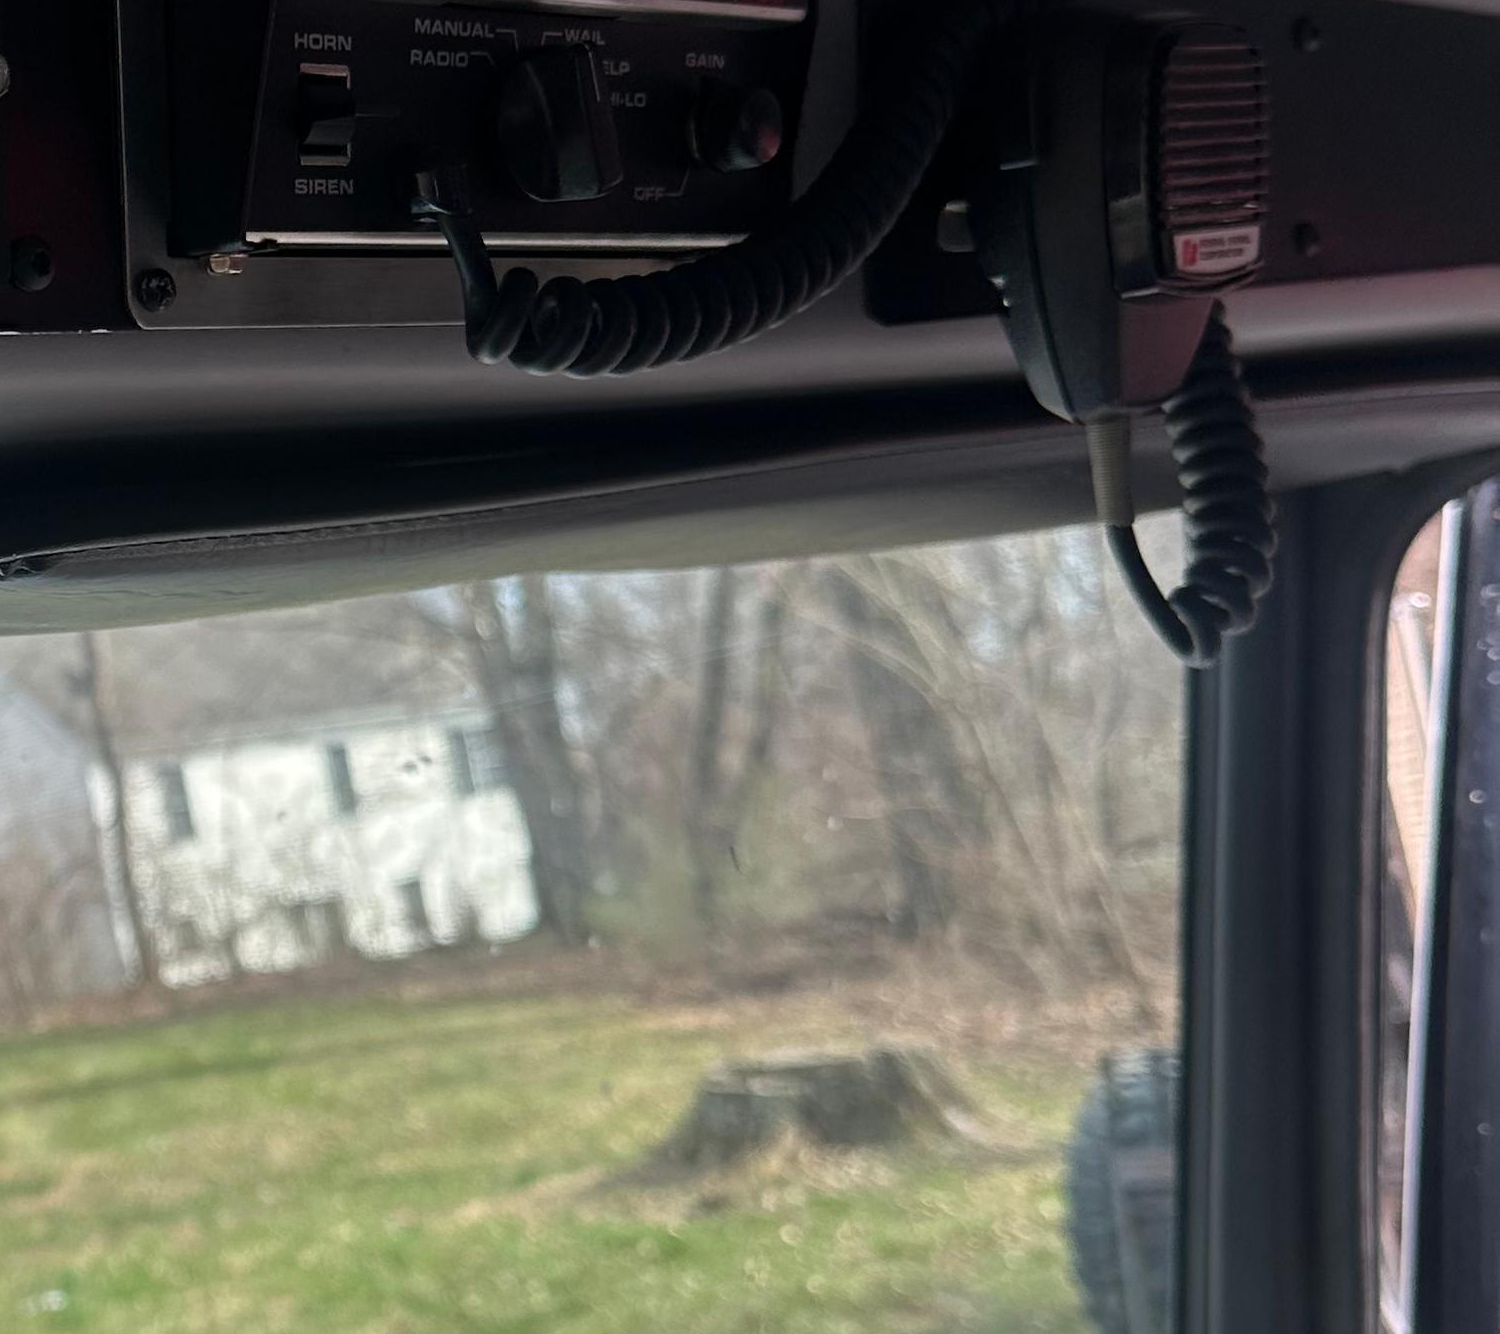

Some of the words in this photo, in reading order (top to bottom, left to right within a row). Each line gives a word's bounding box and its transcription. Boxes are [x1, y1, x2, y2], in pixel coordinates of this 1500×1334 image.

[414, 17, 495, 39] MANUAL
[563, 27, 606, 47] WAIL
[293, 32, 353, 52] HORN
[410, 49, 469, 69] RADIO
[685, 52, 726, 70] GAIN
[294, 178, 355, 197] SIREN
[633, 187, 665, 202] OFF
